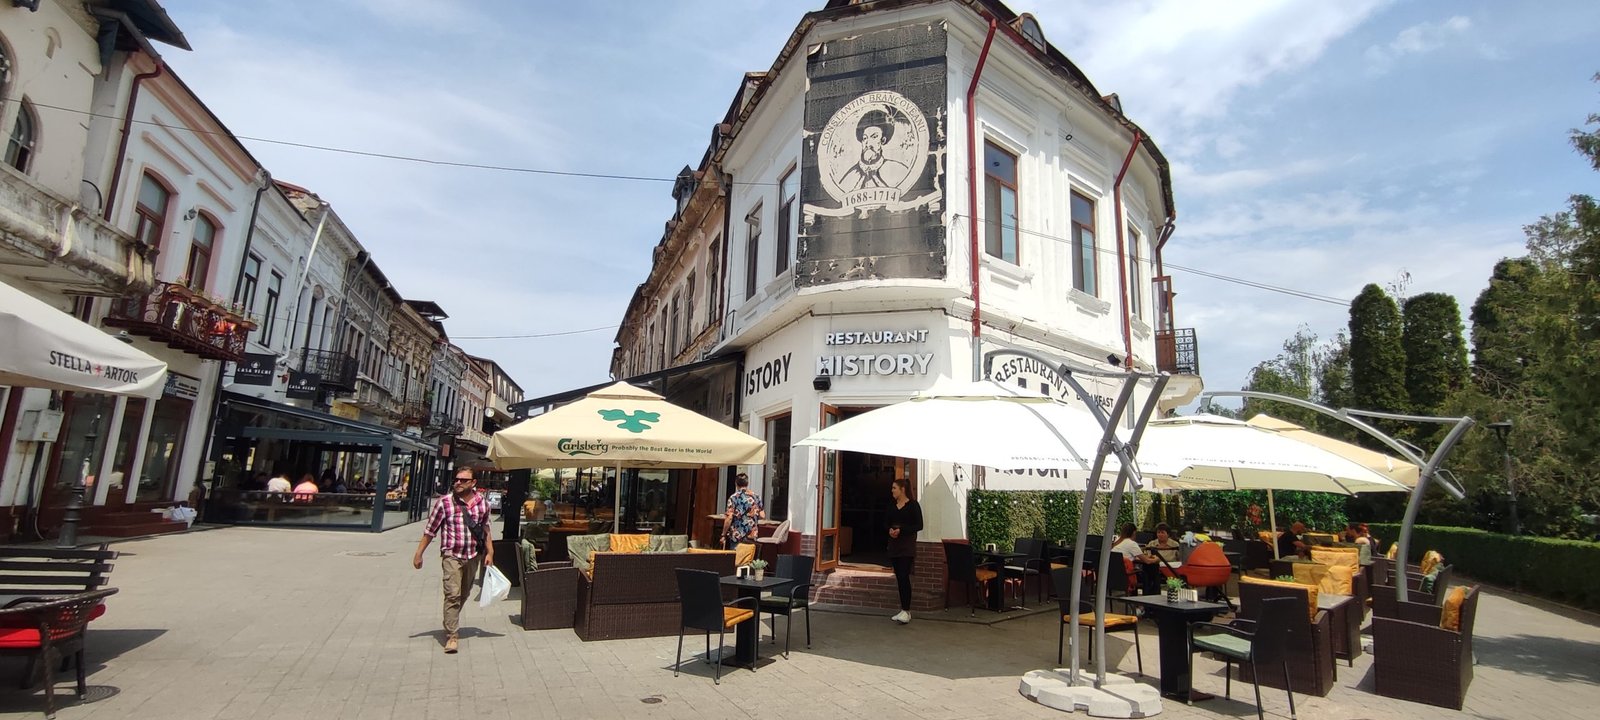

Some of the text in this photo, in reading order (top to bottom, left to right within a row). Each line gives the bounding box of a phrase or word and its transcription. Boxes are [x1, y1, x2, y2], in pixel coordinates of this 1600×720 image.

[821, 93, 926, 146] CONSTANTIN BRANCOVEANU
[845, 190, 897, 207] 1688-1714
[826, 329, 929, 346] RESTAURANT
[50, 350, 139, 384] STELLA ARTOIS
[745, 352, 792, 397] ISTORY
[816, 353, 935, 377] HISTORY
[995, 357, 1069, 400] RESTAURANT
[557, 438, 609, 456] Carlsberg
[611, 444, 638, 452] Probably
